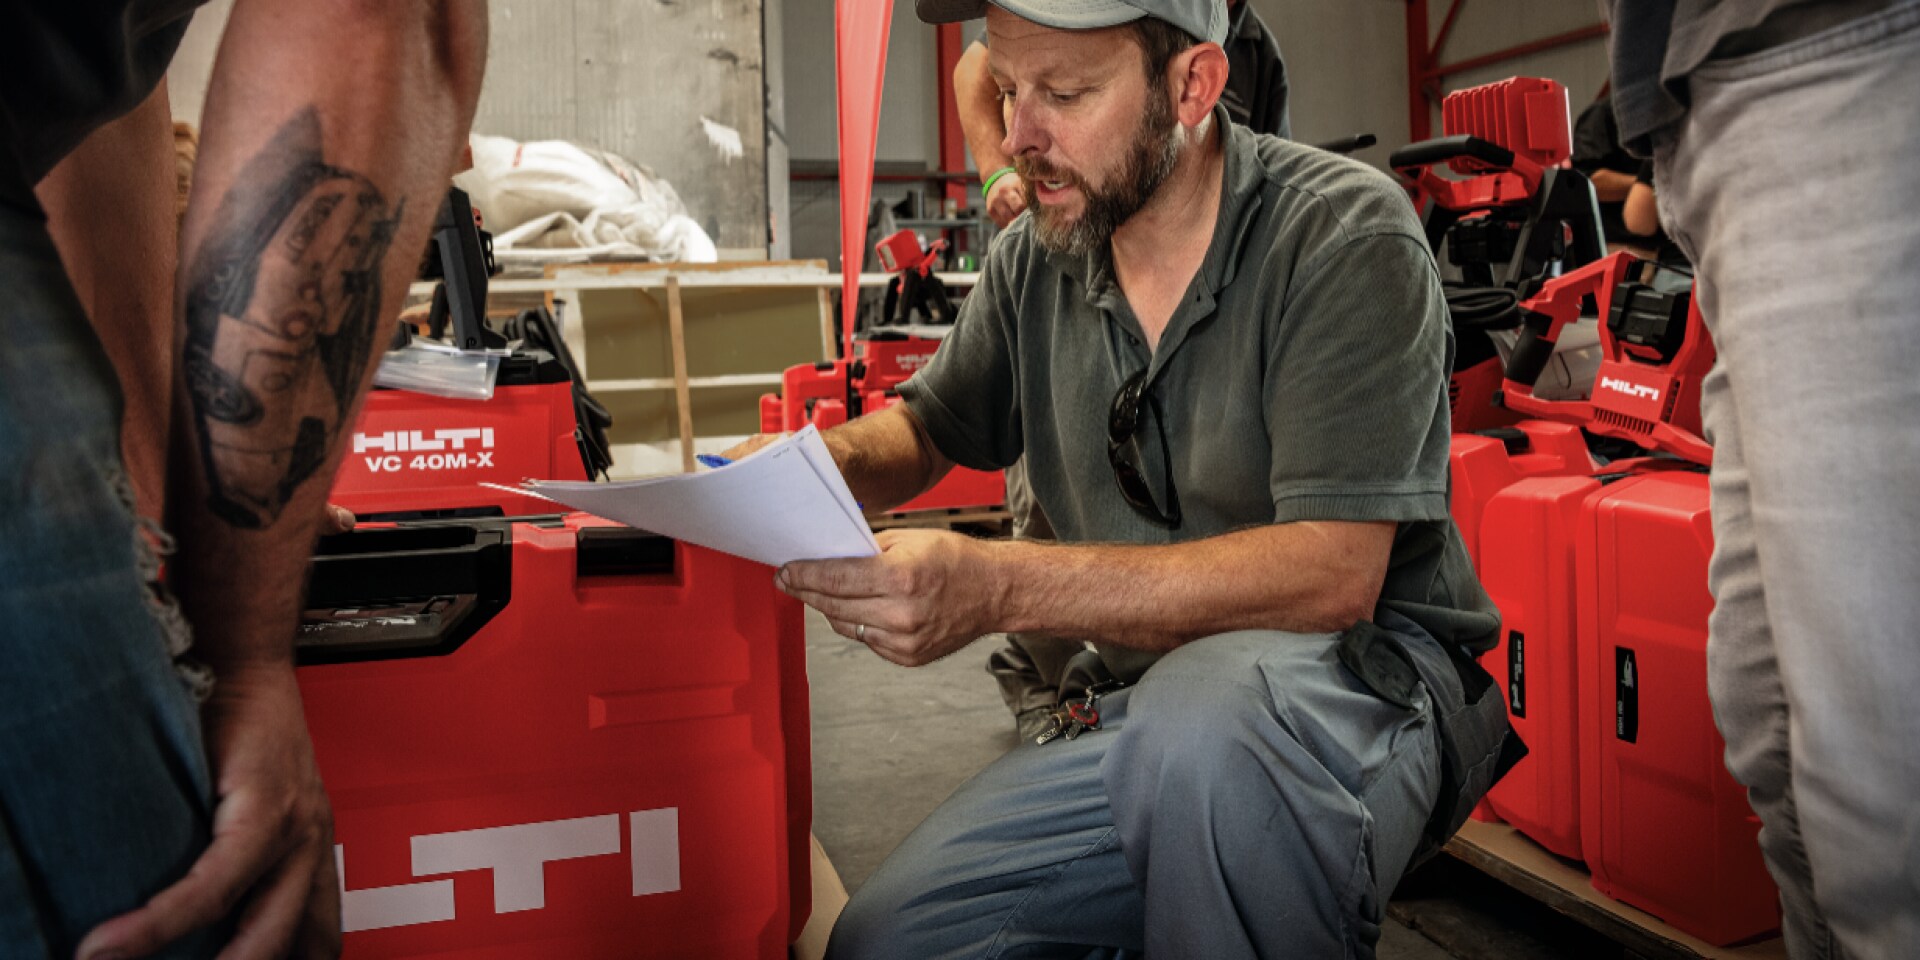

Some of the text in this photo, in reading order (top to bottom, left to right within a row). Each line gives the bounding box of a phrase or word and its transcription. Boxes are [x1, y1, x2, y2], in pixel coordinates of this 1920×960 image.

[1601, 376, 1660, 401] HILTI
[353, 427, 494, 453] HILTI
[365, 452, 494, 472] VC 40M-X
[334, 806, 681, 933] LTI
